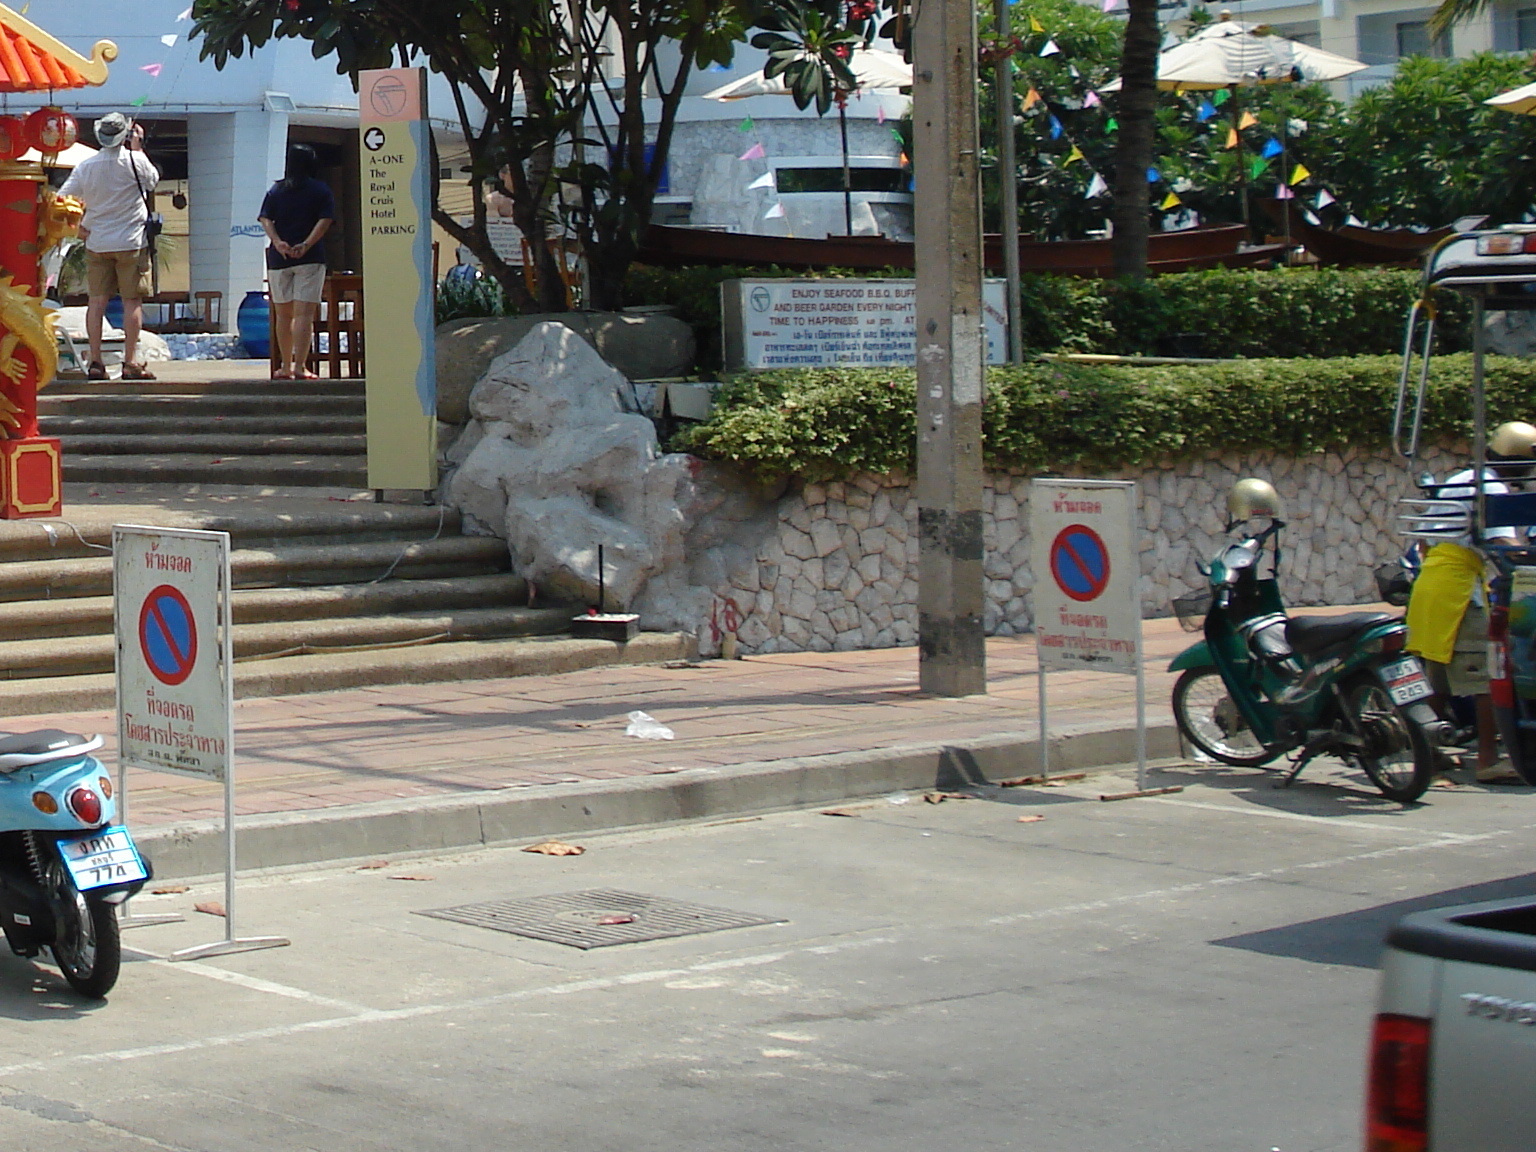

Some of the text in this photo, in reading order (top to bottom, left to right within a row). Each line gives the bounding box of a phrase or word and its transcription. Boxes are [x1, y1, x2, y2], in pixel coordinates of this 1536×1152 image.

[369, 154, 405, 165] A-ONE
[370, 169, 387, 178] The
[370, 180, 395, 194] Royal
[371, 208, 396, 219] Hotel
[371, 224, 415, 235] PARKING
[792, 289, 820, 298] ENJOY
[824, 289, 864, 298] SEAFOOD
[773, 303, 912, 312] AND BEER GARDEN EVERY NIGHT
[769, 316, 790, 326] TIME
[793, 316, 805, 326] TO
[808, 316, 859, 325] HAPPINESS
[145, 542, 191, 573] ห้ามจอด
[147, 686, 194, 722] ที่จอดรถ
